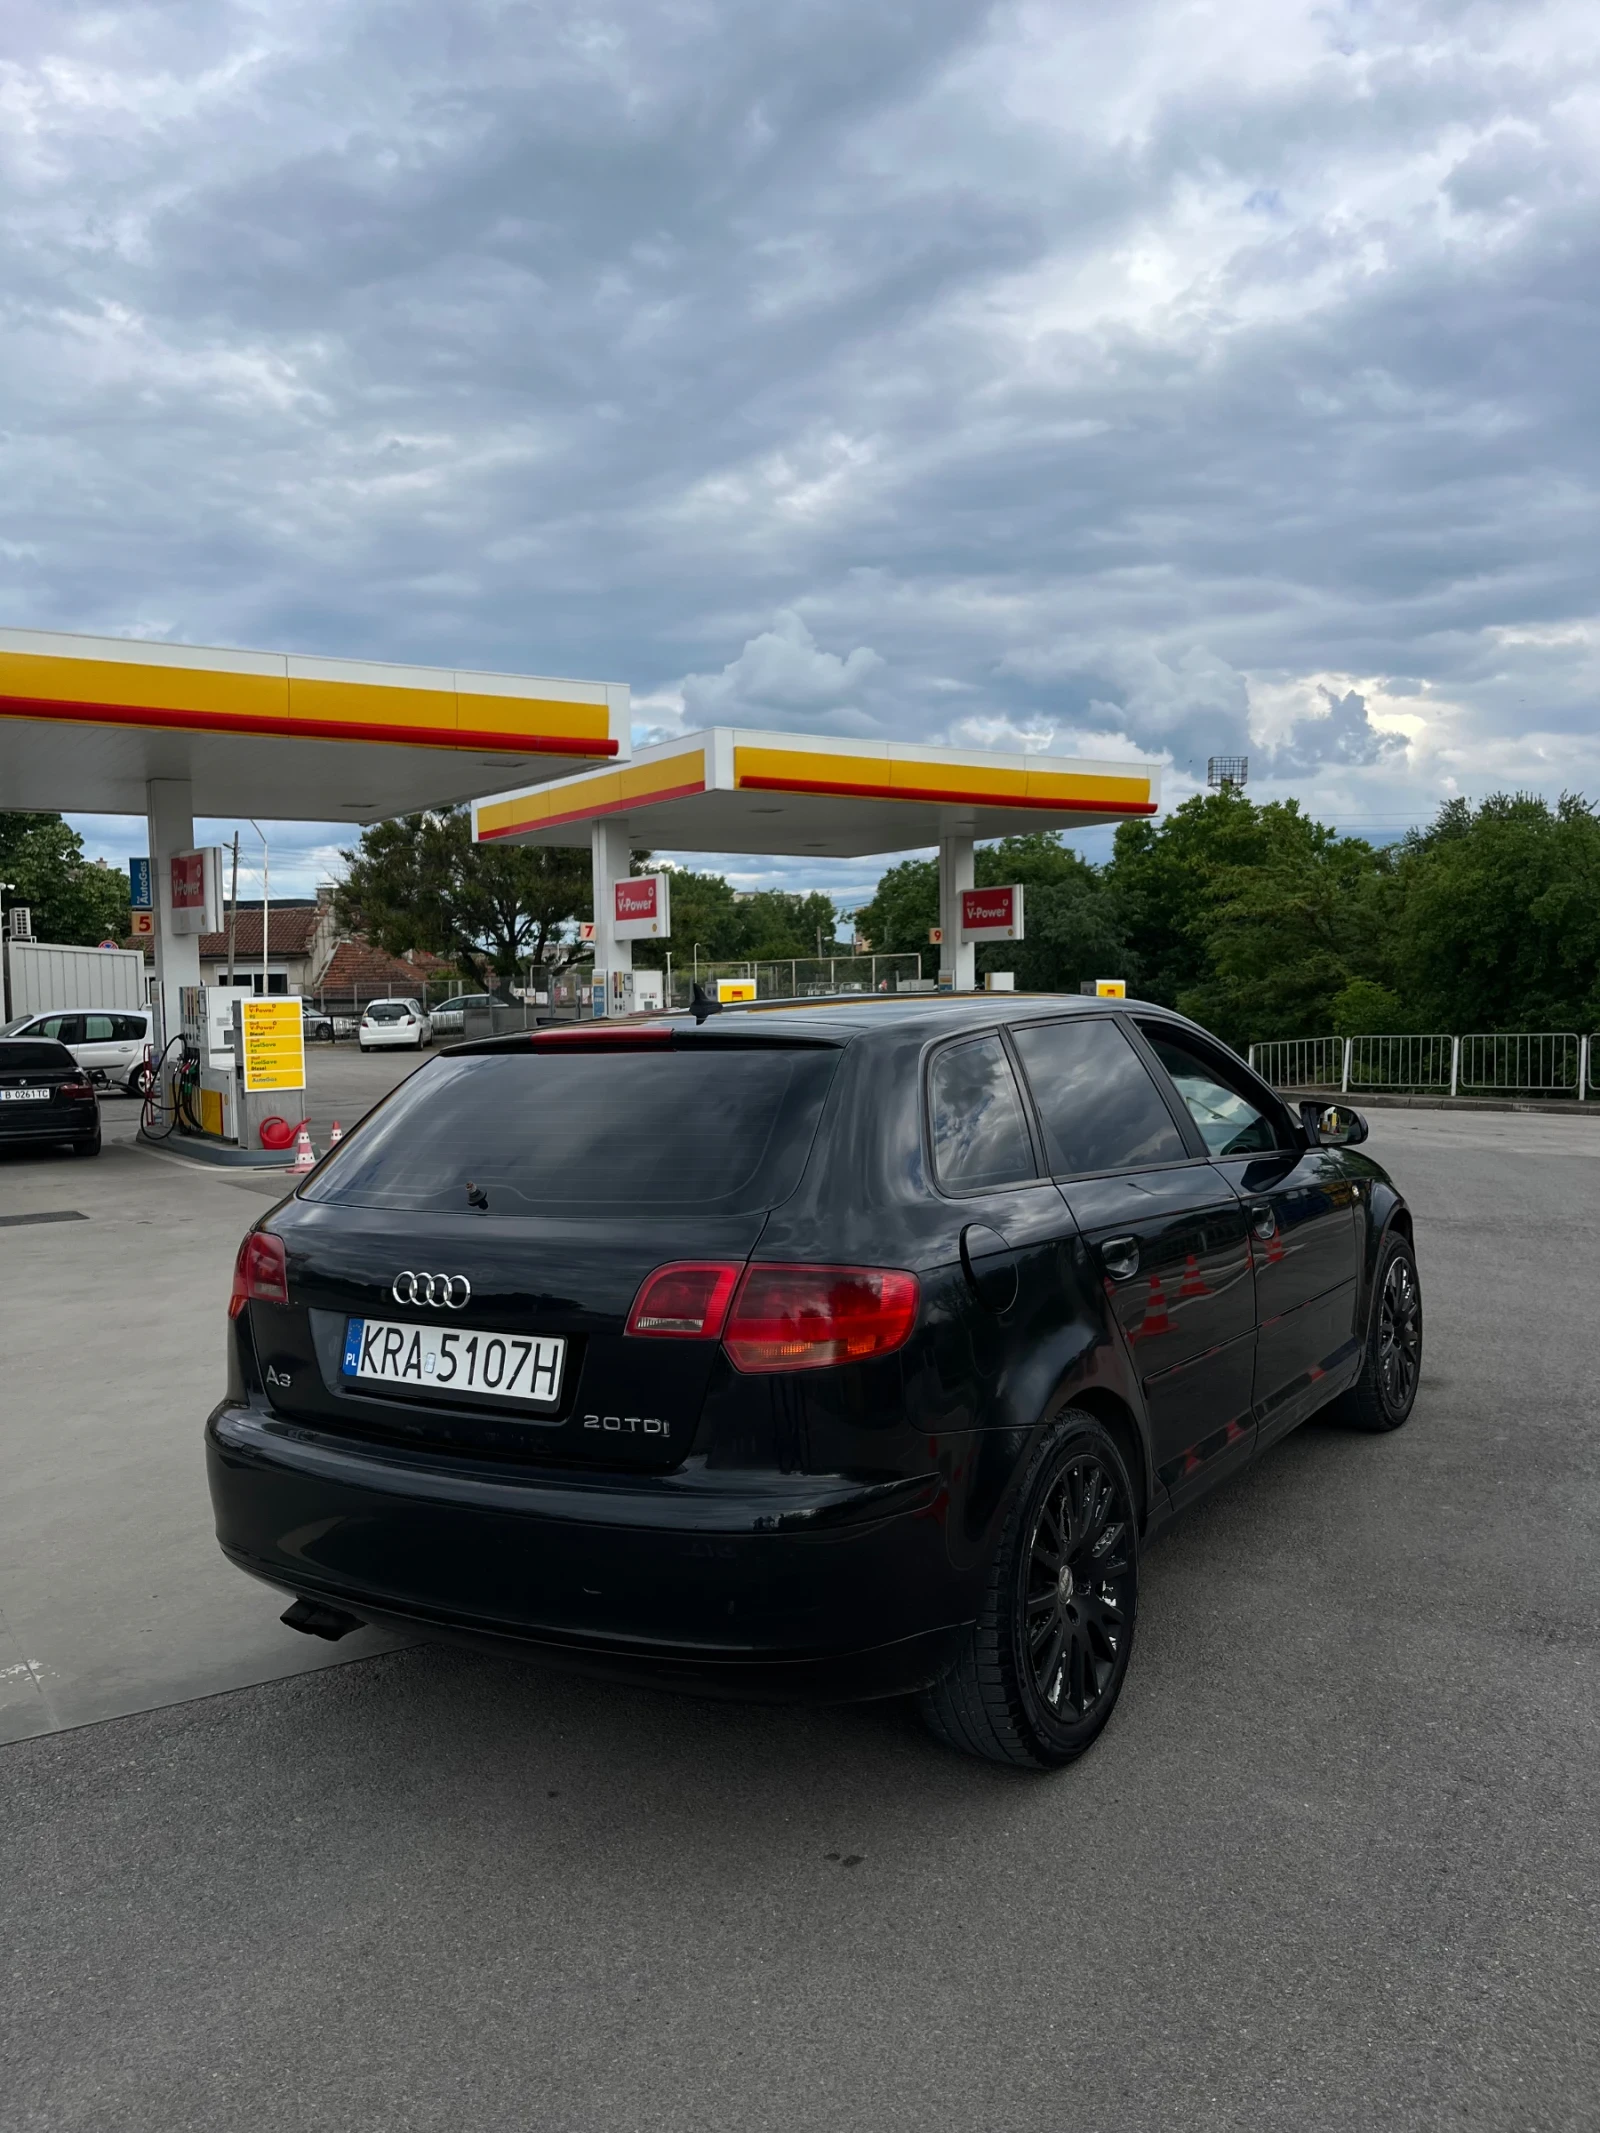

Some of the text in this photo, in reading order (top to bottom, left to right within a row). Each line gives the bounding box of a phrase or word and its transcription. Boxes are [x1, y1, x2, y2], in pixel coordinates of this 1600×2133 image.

[138, 860, 149, 904] AutoGas
[173, 879, 201, 897] V-Power
[617, 897, 653, 912] V-Power
[966, 906, 1007, 920] V-Power
[138, 915, 151, 932] 5
[585, 925, 594, 938] 7
[934, 930, 942, 941] 9
[345, 1352, 357, 1366] PL
[360, 1325, 559, 1395] KRA 5107H
[266, 1365, 291, 1387] A3
